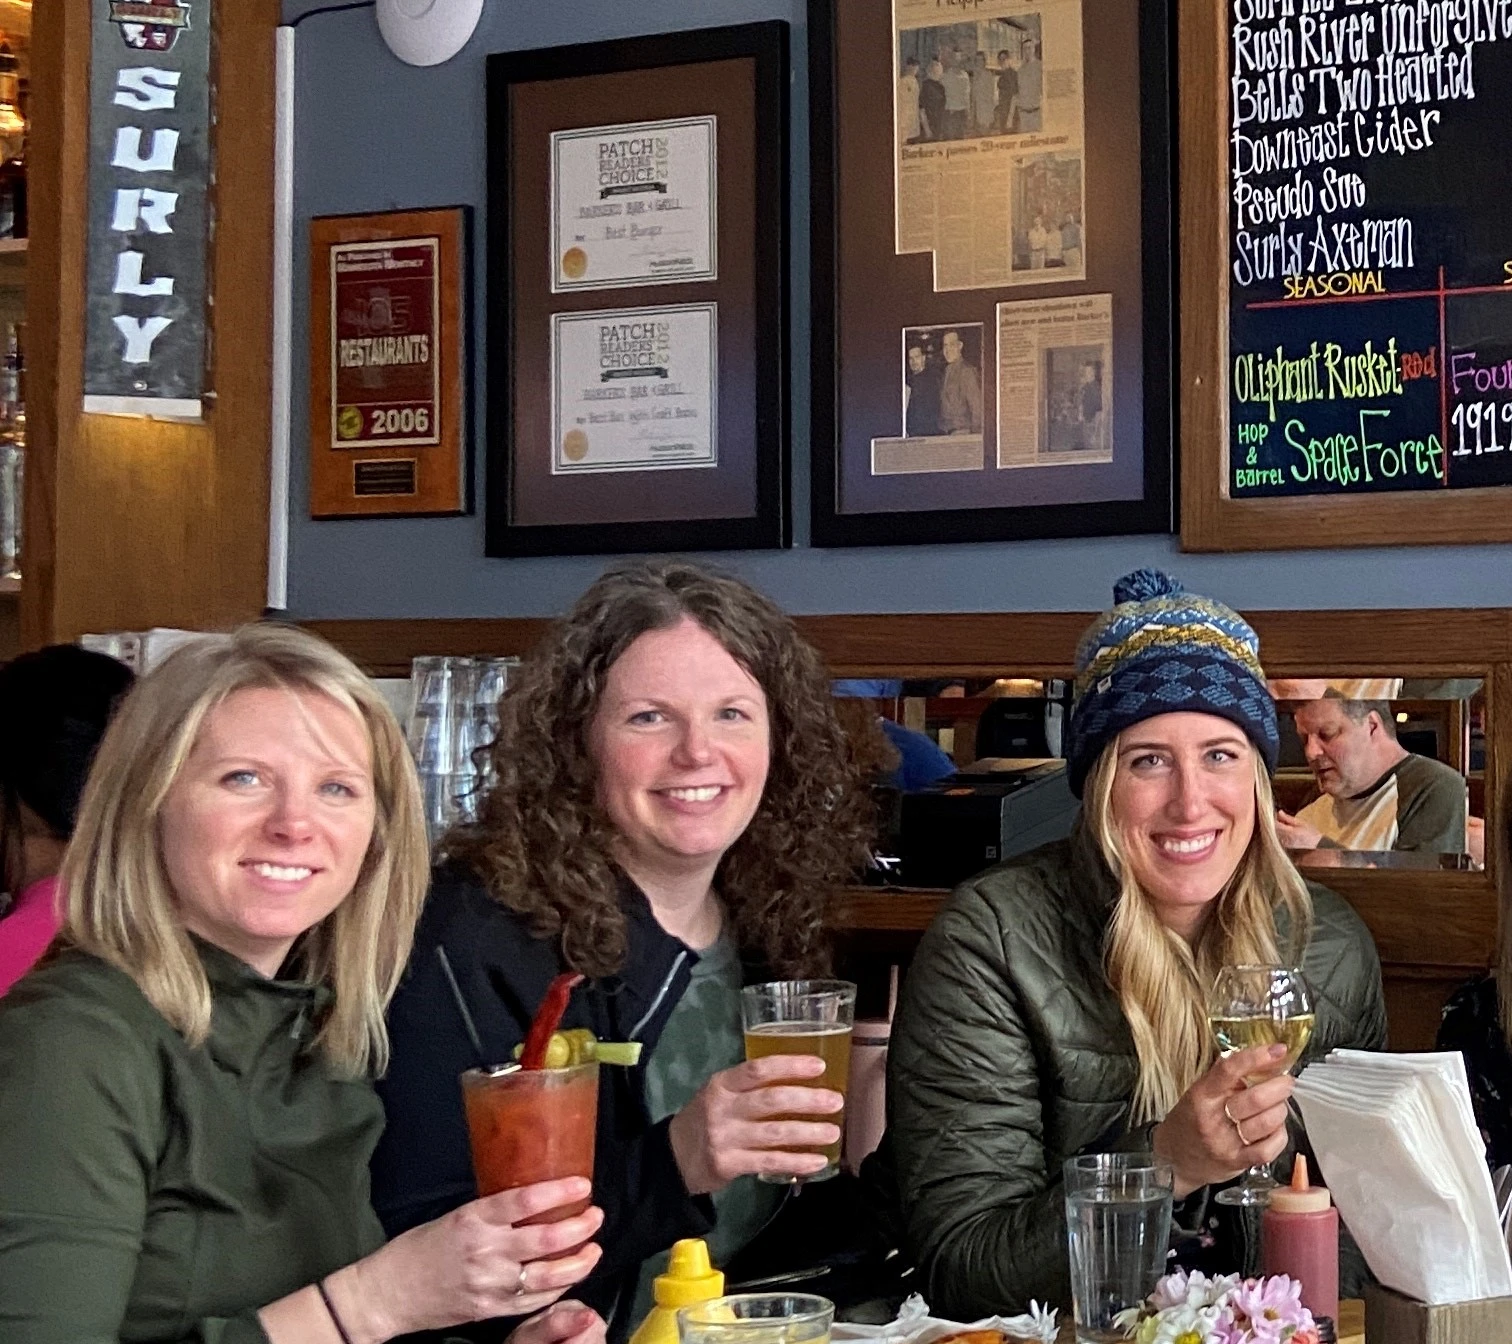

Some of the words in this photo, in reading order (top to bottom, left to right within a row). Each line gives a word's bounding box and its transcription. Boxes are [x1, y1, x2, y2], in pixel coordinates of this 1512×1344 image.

[1232, 16, 1295, 75] Rush
[1299, 11, 1375, 68] River
[1232, 68, 1305, 128] Bells
[1310, 66, 1371, 115] Two
[1375, 42, 1475, 106] Hearted
[599, 138, 653, 158] PATCH
[1231, 107, 1350, 179] Downeast
[1354, 106, 1440, 157] Cider
[599, 166, 655, 185] CHOICE
[1233, 170, 1313, 229] Pseudo
[1320, 167, 1366, 213] Sue
[112, 67, 181, 363] SURLY
[1233, 221, 1303, 287] Surly
[1307, 215, 1414, 273] Axeman
[1283, 271, 1386, 299] SEASONAL
[340, 335, 429, 368] RESTAURANTS
[600, 323, 655, 342] PATCH
[600, 352, 656, 368] CHOICE
[1235, 341, 1323, 422] Oliphant
[370, 408, 430, 434] 2006
[1246, 446, 1258, 465] &
[1285, 419, 1360, 486] Space
[1359, 409, 1443, 482] Force
